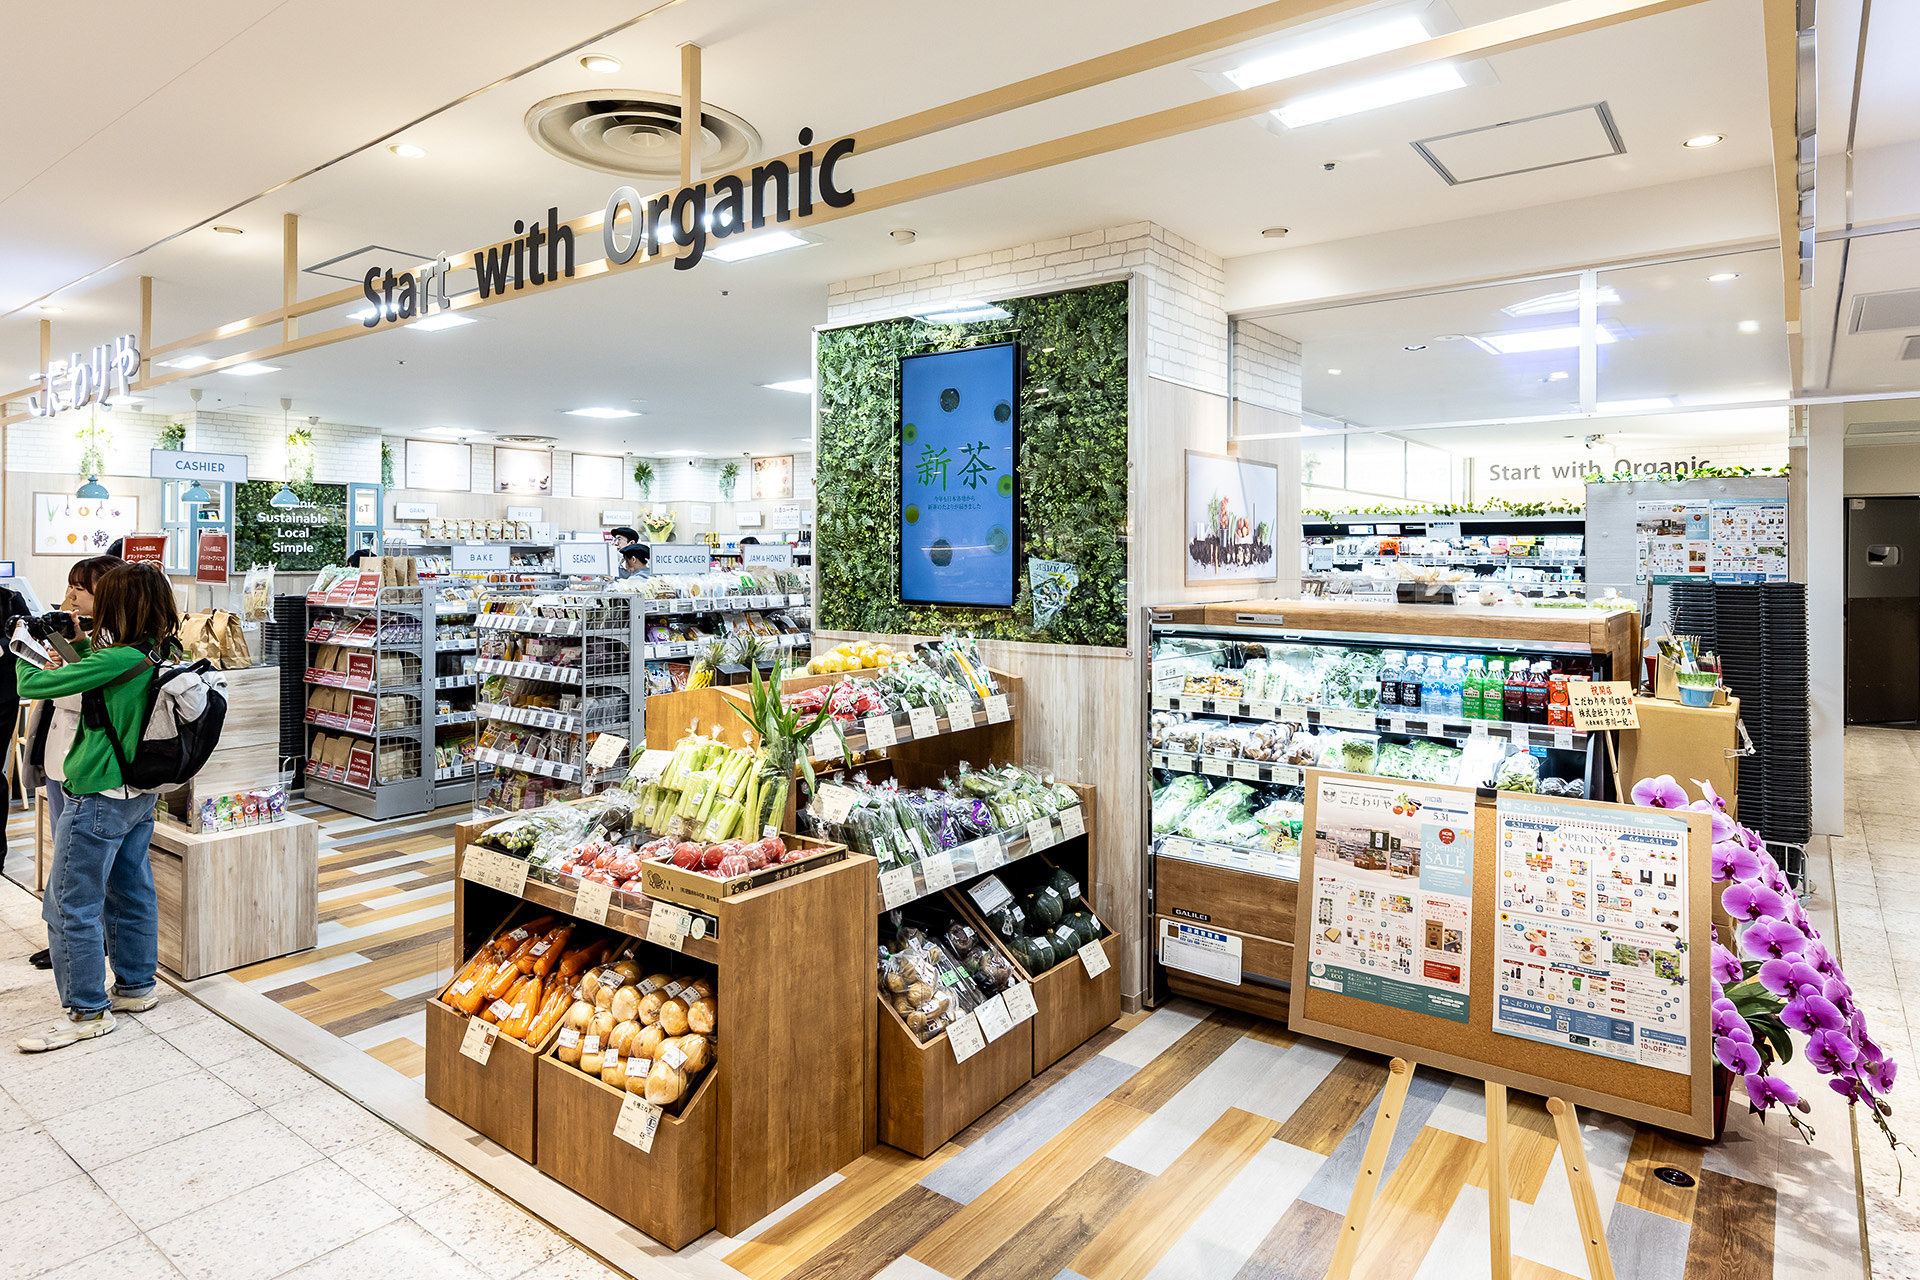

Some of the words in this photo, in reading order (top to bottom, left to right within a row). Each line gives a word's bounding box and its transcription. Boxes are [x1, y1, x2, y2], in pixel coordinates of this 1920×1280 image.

[363, 251, 451, 327] Start
[474, 207, 575, 299] with
[603, 127, 855, 271] Organic
[28, 334, 141, 417] こだわりや
[175, 459, 226, 473] CASHIER
[915, 441, 997, 492] 新茶
[1489, 463, 1541, 482] Start
[1552, 460, 1601, 480] with
[257, 512, 328, 524] Sustainable
[277, 527, 309, 538] Local
[272, 542, 314, 555] Simple
[572, 554, 596, 563] SEASON
[655, 555, 672, 563] RICE
[674, 555, 706, 564] CRACKER
[749, 555, 761, 563] JAM
[766, 555, 787, 563] HONEY
[1574, 697, 1607, 706] こだわりや
[1339, 796, 1392, 809] こだわりや
[1513, 801, 1560, 814] こだわりや
[1433, 812, 1449, 822] 5.31
[1558, 832, 1612, 846] OPENING
[1425, 840, 1466, 858] Opening
[1568, 845, 1597, 855] SALE
[1425, 852, 1465, 869] SALE
[1175, 908, 1208, 921] GALILEI
[1510, 1000, 1542, 1011] こだわりや
